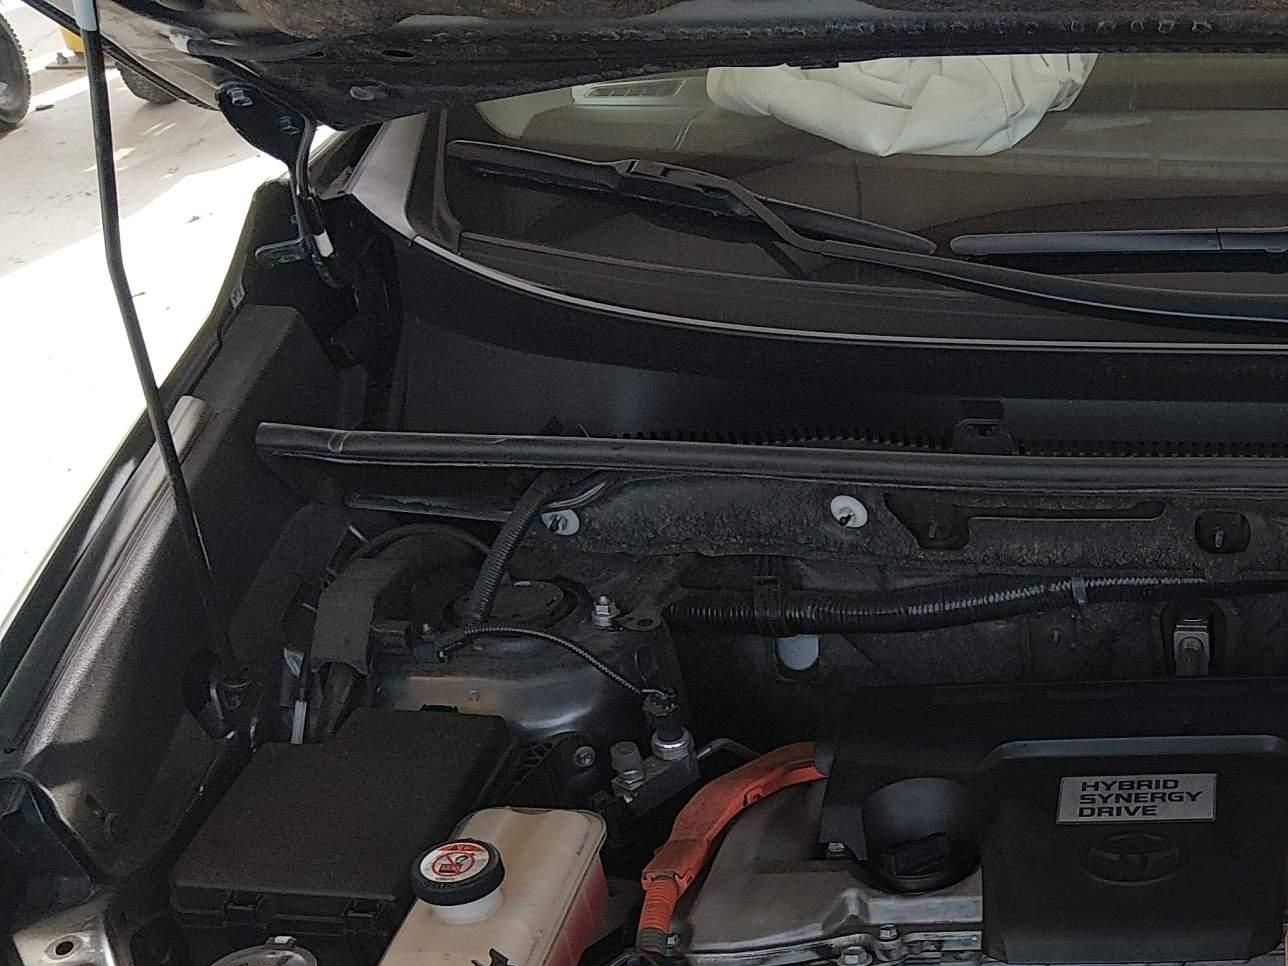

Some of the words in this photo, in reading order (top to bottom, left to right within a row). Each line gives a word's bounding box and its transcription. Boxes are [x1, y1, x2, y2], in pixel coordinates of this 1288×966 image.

[1081, 779, 1179, 792] HYBRID
[1079, 791, 1203, 805] SYNERGY
[1078, 805, 1158, 818] DRIVE
